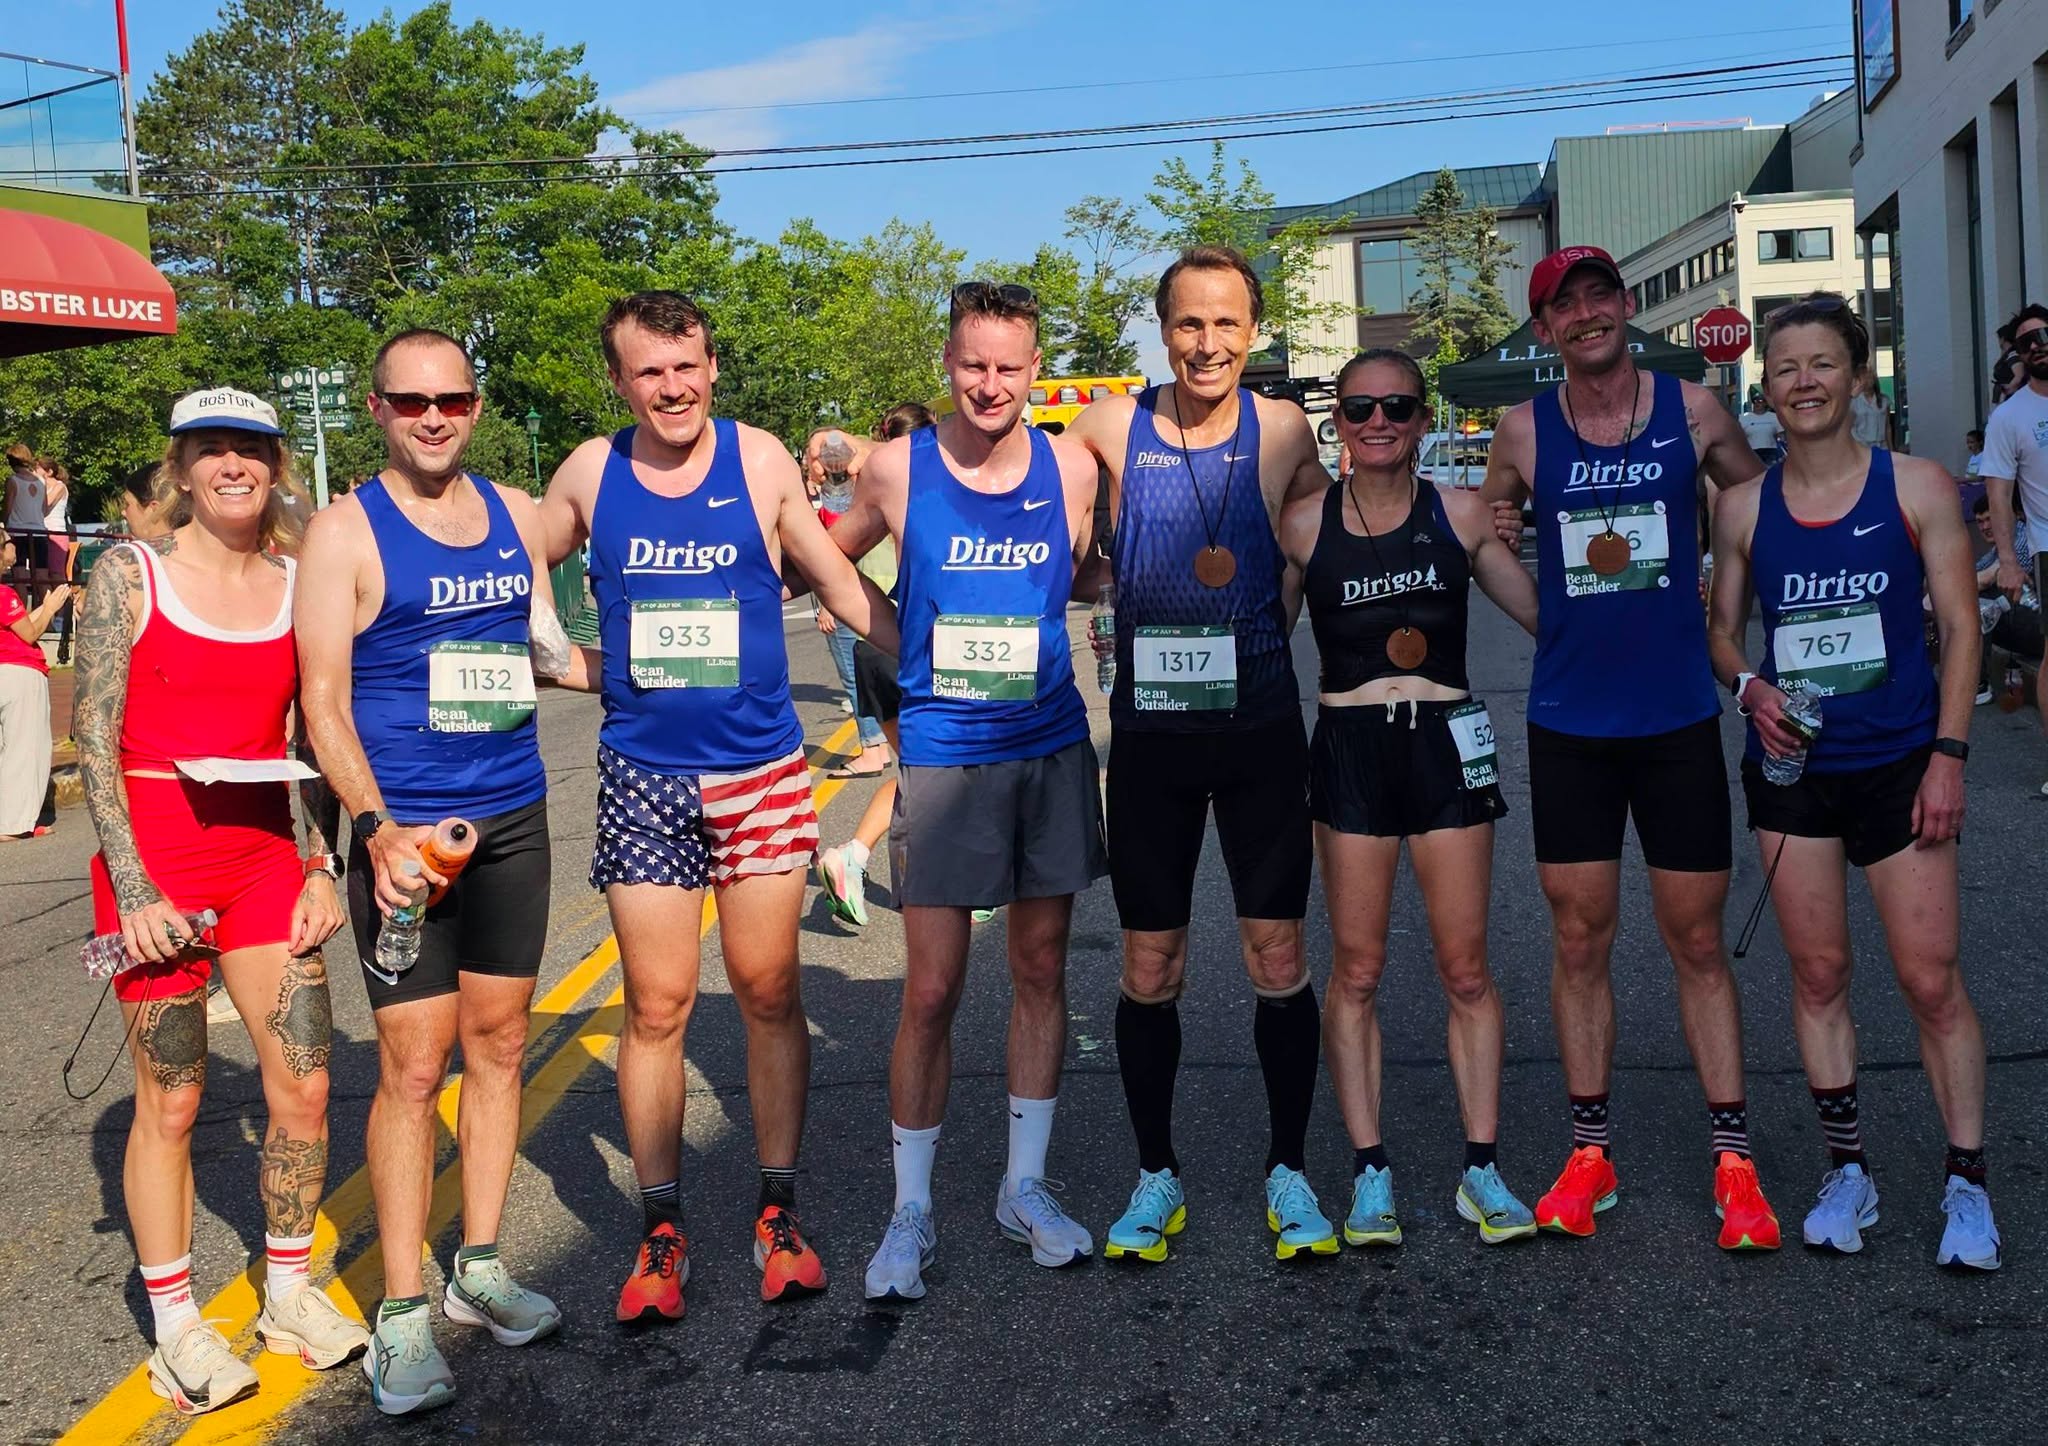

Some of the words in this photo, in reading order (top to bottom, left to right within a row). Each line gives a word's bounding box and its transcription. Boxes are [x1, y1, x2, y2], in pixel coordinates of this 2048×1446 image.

[0, 289, 87, 316] BSTER
[92, 296, 162, 322] LUXE
[1698, 323, 1748, 347] STOP
[199, 392, 256, 408] BOSTON
[320, 394, 334, 404] ART
[1134, 452, 1181, 468] Dirigo
[1563, 458, 1663, 493] Dirigo
[622, 538, 738, 574] Dirigo
[941, 536, 1050, 571] Dirigo
[1341, 570, 1422, 605] Dirigo
[1565, 573, 1598, 586] Bean
[425, 572, 530, 614] Dirigo
[1568, 582, 1621, 596] utsider
[1778, 568, 1889, 610] Dirigo
[658, 625, 711, 647] 933
[963, 640, 1011, 662] 332
[1799, 632, 1851, 658] 767
[1159, 651, 1211, 672] 1317
[1852, 661, 1885, 671] L.L.Bean
[630, 664, 664, 676] Bean
[458, 668, 512, 690] 1132
[933, 674, 968, 686] Bean
[1205, 682, 1234, 690] L.L.Bean
[1778, 678, 1810, 690] Bean
[933, 684, 989, 700] Outsider
[1134, 688, 1168, 699] Bean
[1134, 697, 1189, 711] Outsider
[429, 708, 468, 719] Bean
[430, 719, 492, 732] Outsider
[1474, 724, 1495, 747] 52
[1463, 764, 1492, 779] Bean
